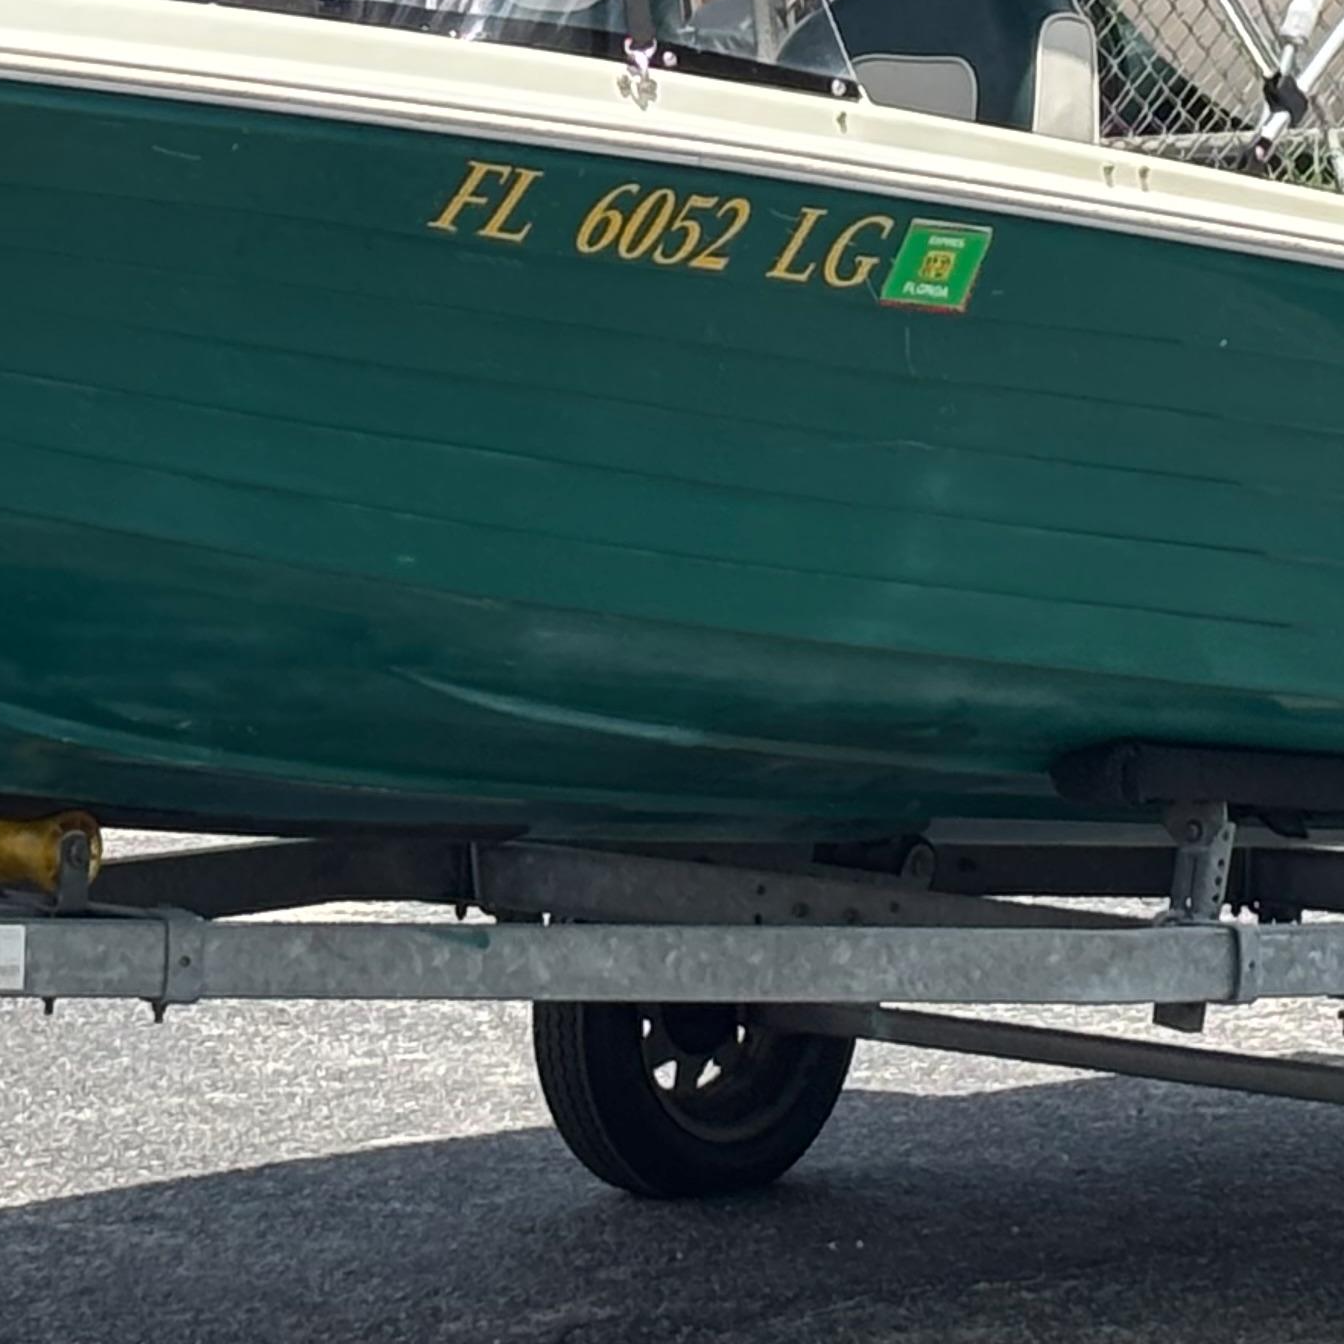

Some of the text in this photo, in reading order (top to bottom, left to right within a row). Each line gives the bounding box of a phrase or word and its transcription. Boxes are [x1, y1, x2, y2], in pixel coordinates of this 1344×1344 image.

[428, 160, 895, 289] FL 6052 LG
